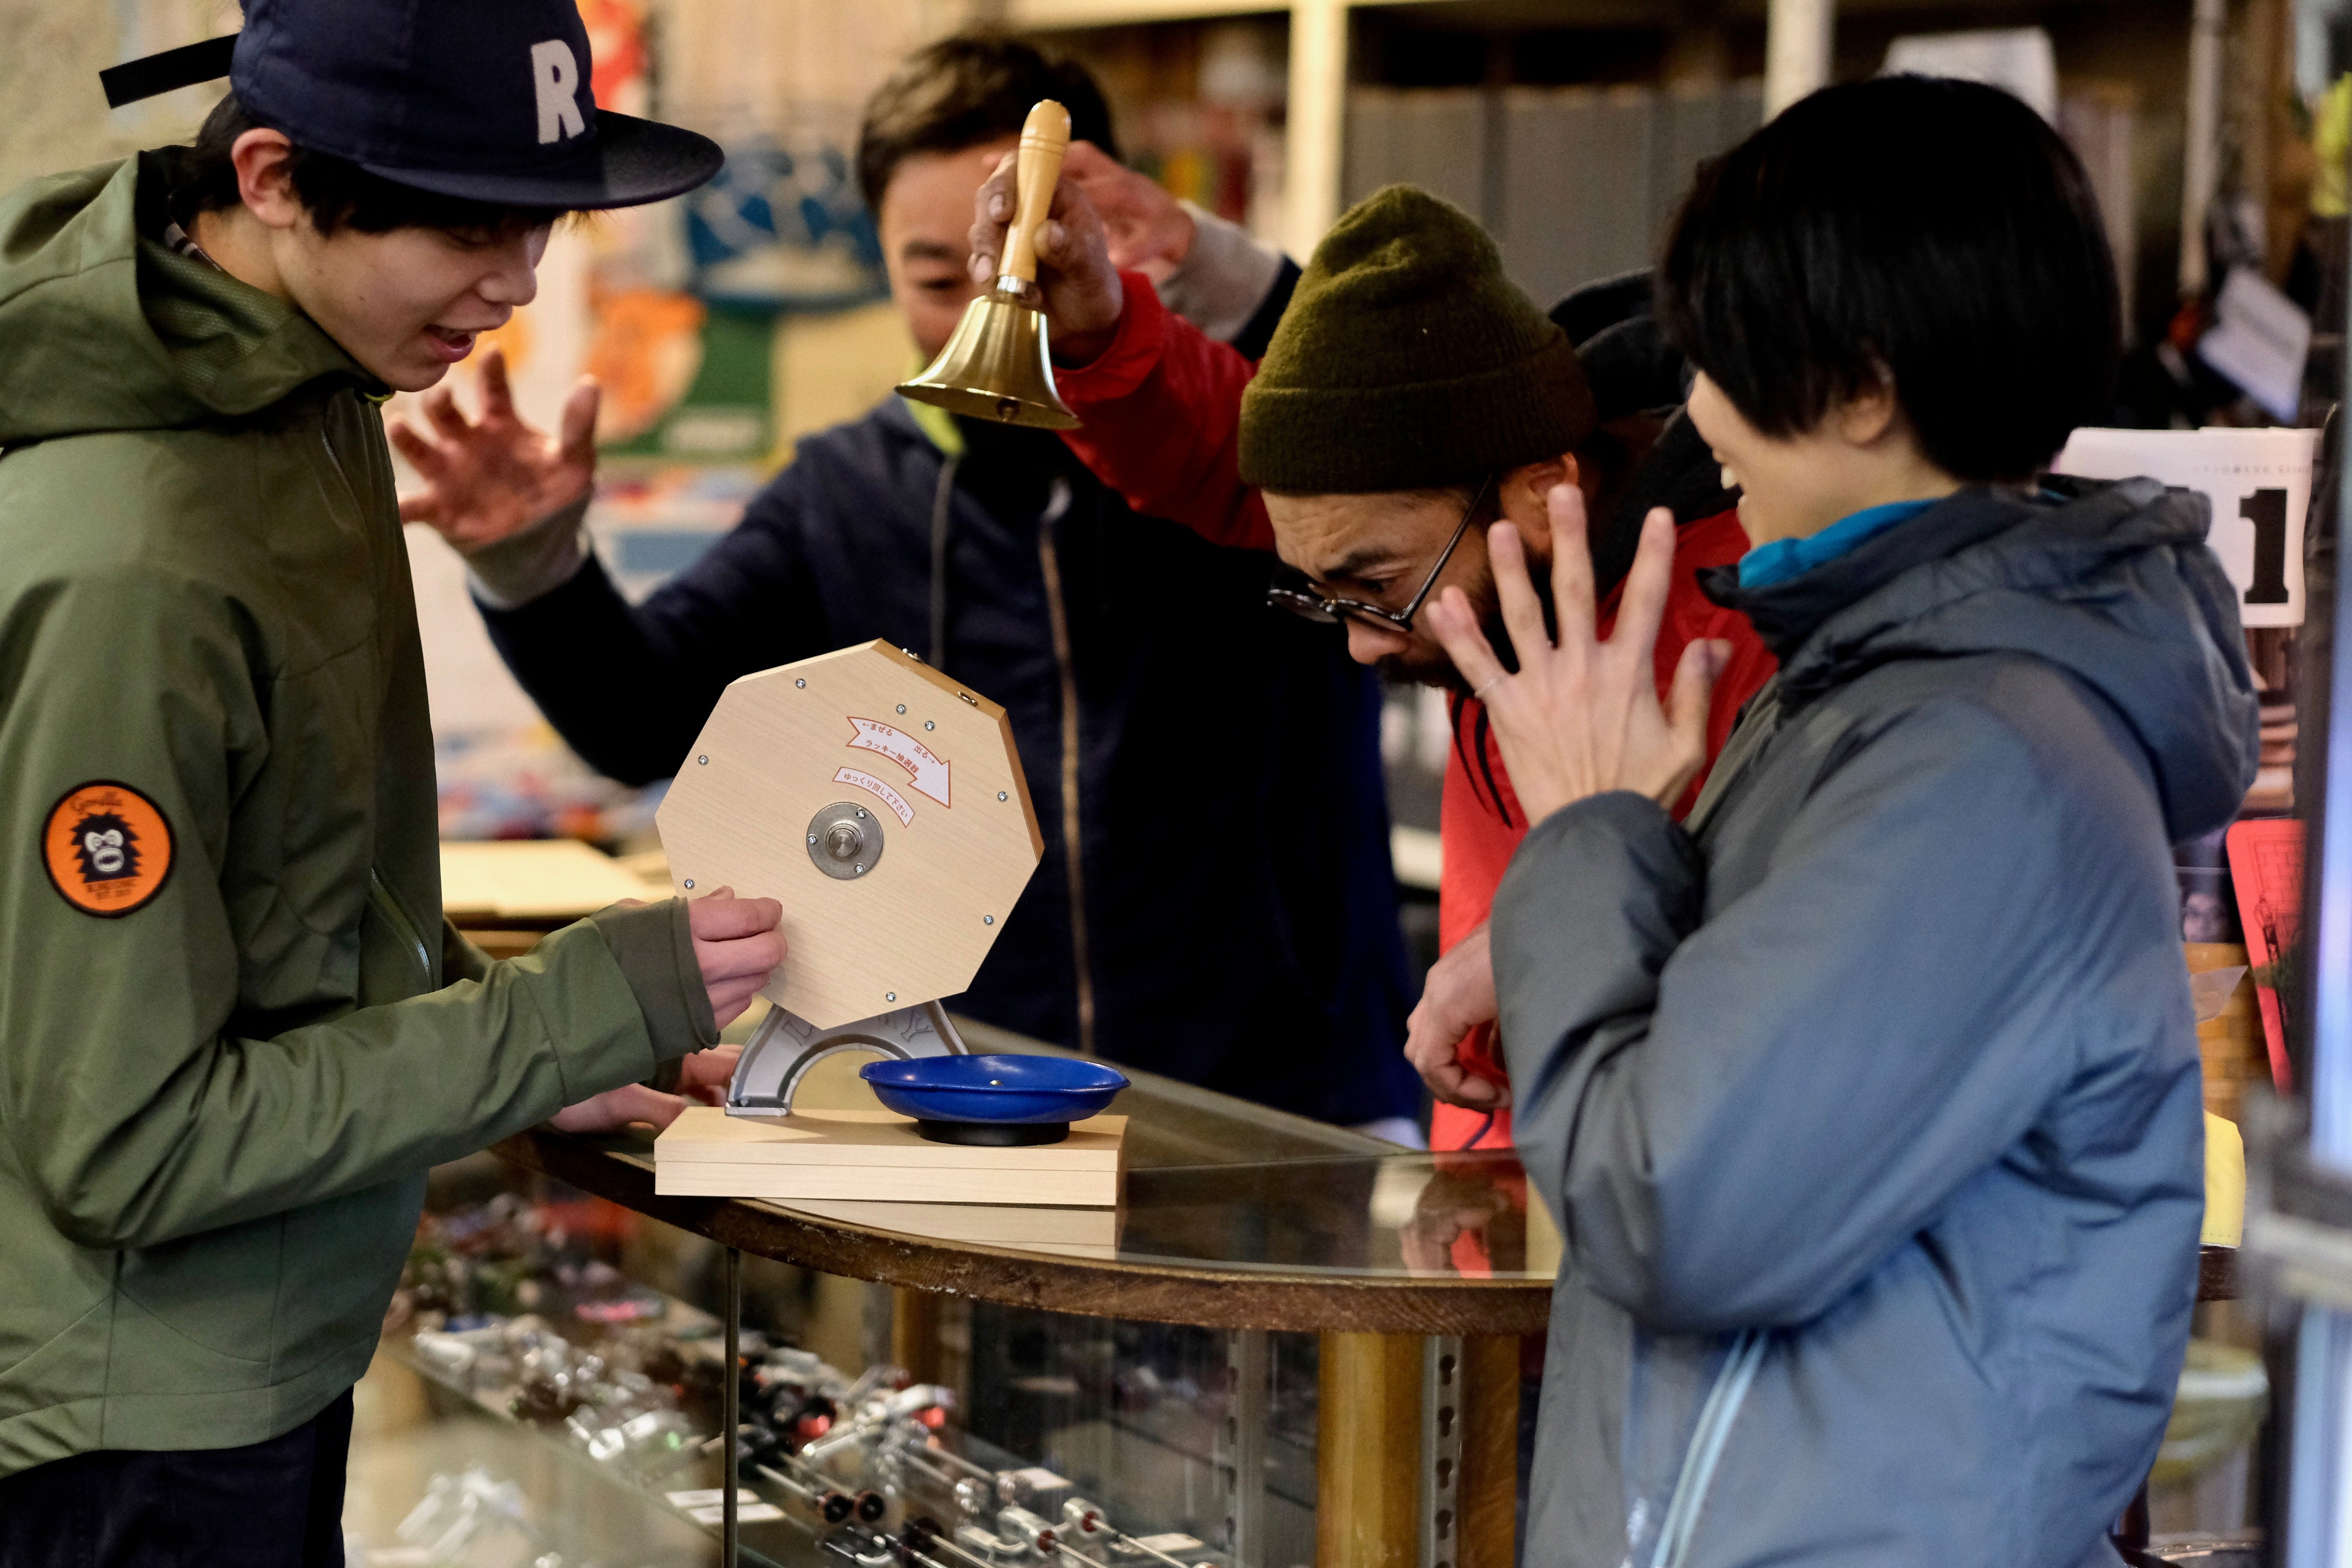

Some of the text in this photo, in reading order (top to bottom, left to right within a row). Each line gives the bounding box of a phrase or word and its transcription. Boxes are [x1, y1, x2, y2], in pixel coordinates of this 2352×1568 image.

[531, 39, 585, 145] R
[870, 723, 893, 736] まぜる
[866, 739, 919, 773] ラッキー抽選器
[913, 744, 929, 758] 出る
[844, 773, 908, 817] ゆっくり回して下さい
